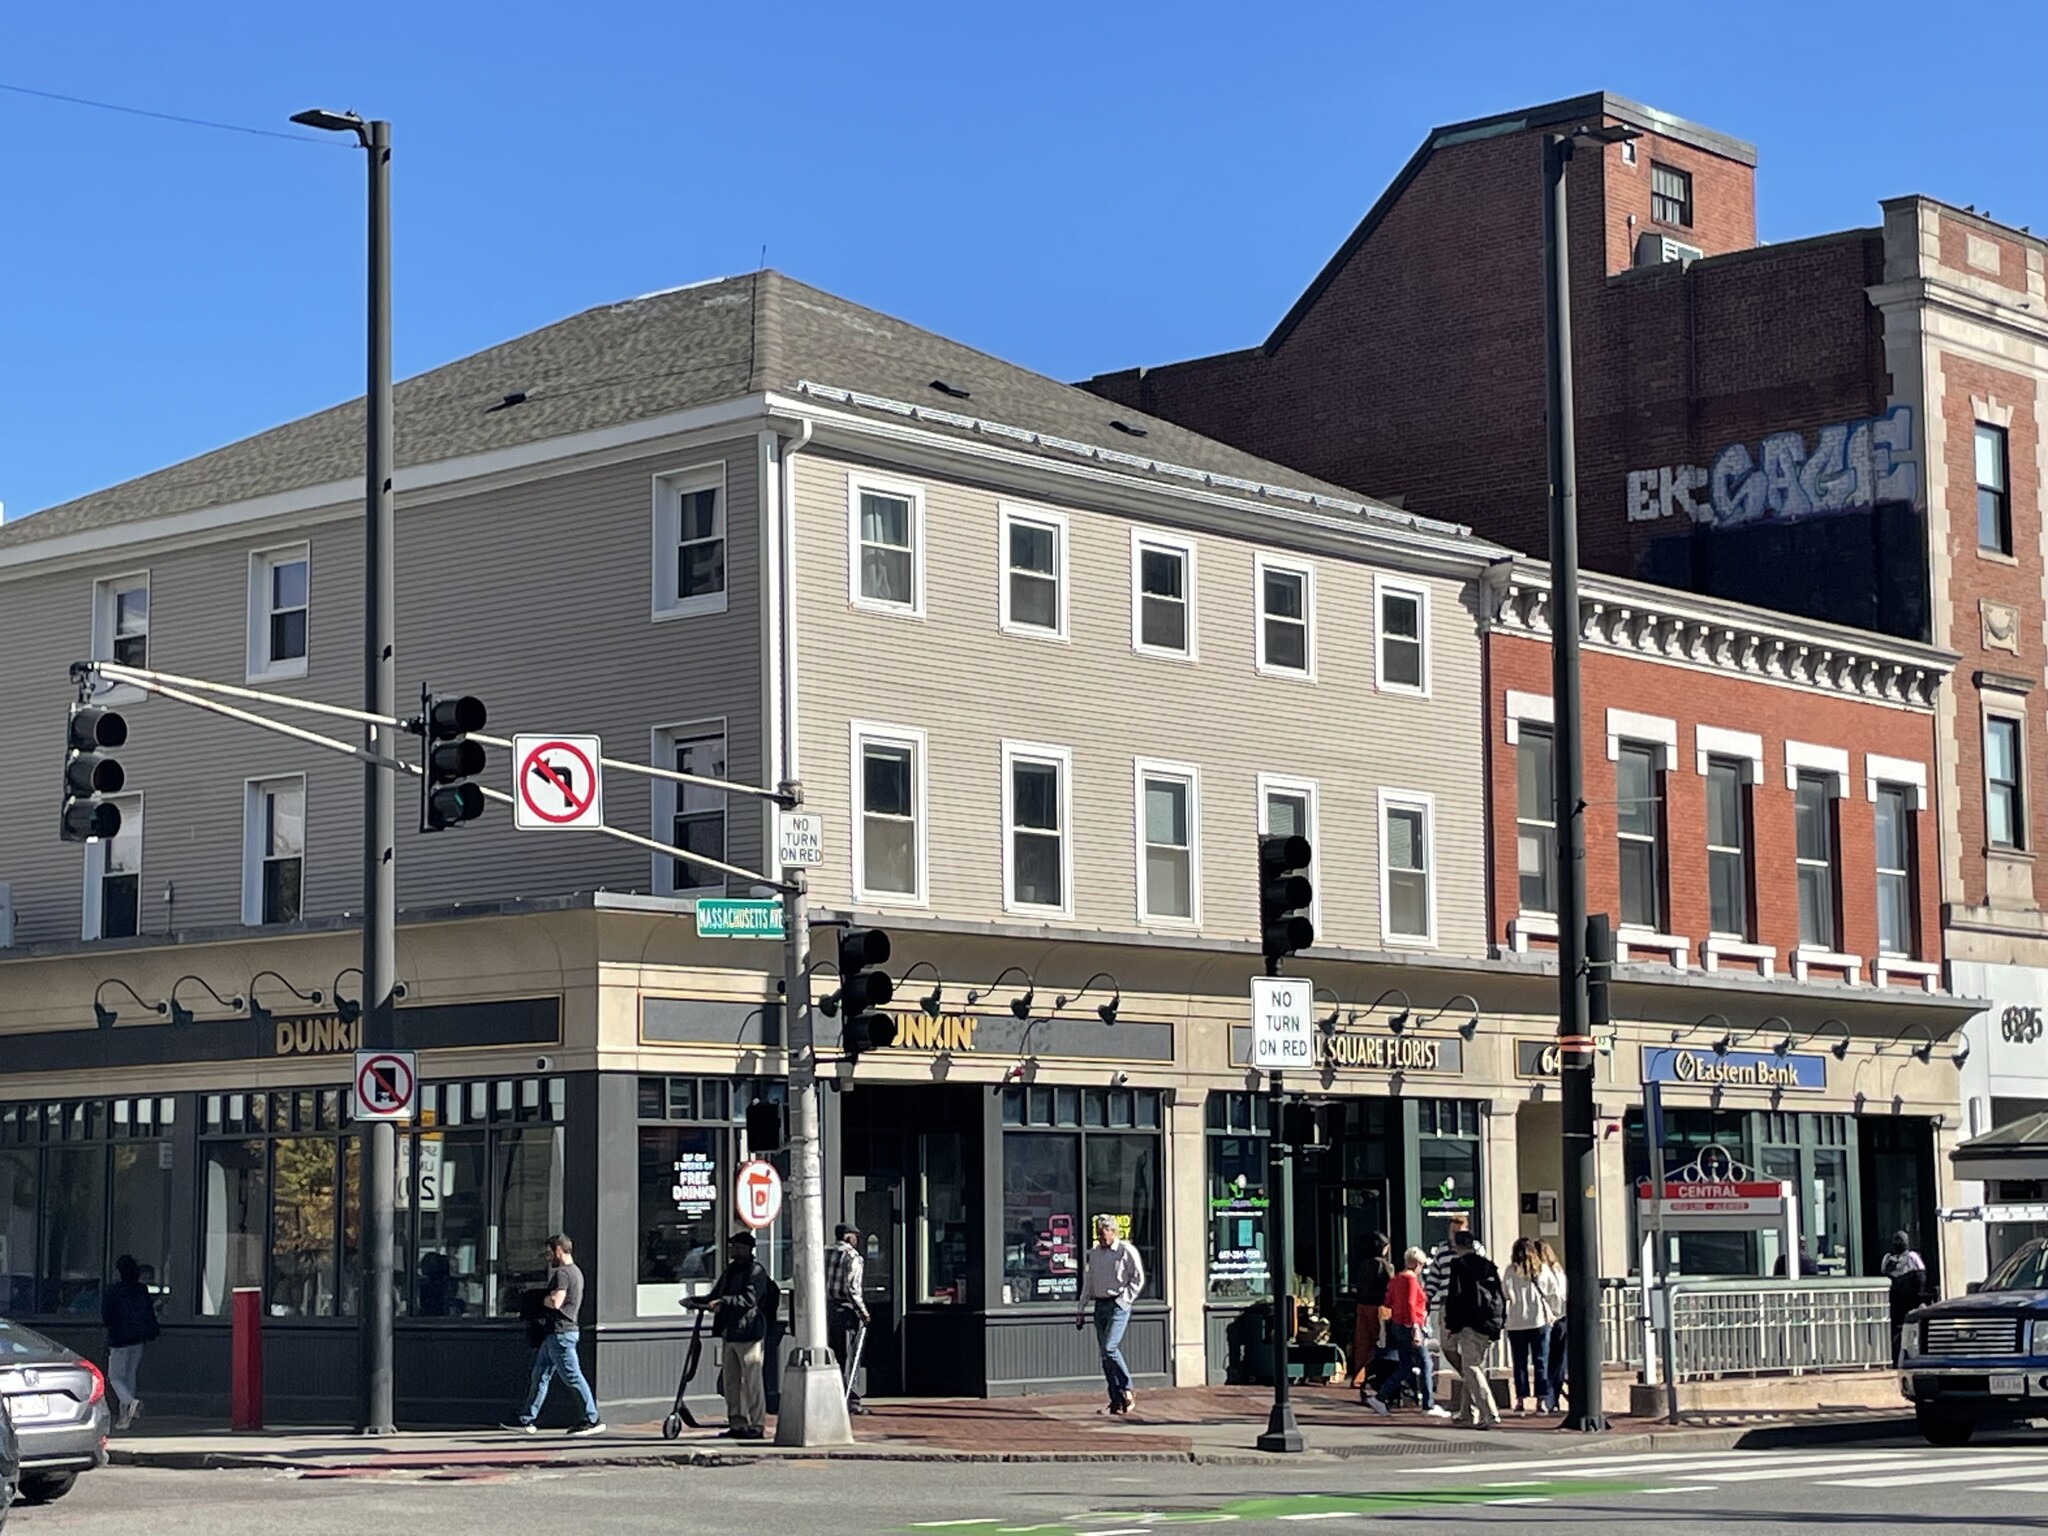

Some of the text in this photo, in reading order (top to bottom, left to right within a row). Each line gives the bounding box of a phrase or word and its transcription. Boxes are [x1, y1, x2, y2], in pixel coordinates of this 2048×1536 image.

[793, 818, 809, 832] NO
[785, 832, 818, 847] TURN
[781, 847, 822, 863] ON RED
[1271, 990, 1292, 1008] NO
[891, 1013, 977, 1051] UNKIN'
[1266, 1014, 1300, 1033] TURN
[276, 1017, 363, 1055] DUNKI
[1259, 1038, 1276, 1057] ON
[1283, 1039, 1307, 1058] RED
[1327, 1036, 1384, 1066] SQUARE
[1387, 1038, 1441, 1068] FLORIST
[1696, 1057, 1799, 1086] Eastern Bank
[680, 1171, 711, 1186] FREE
[672, 1185, 717, 1200] DRINKS
[1678, 1184, 1740, 1199] CENTRAL
